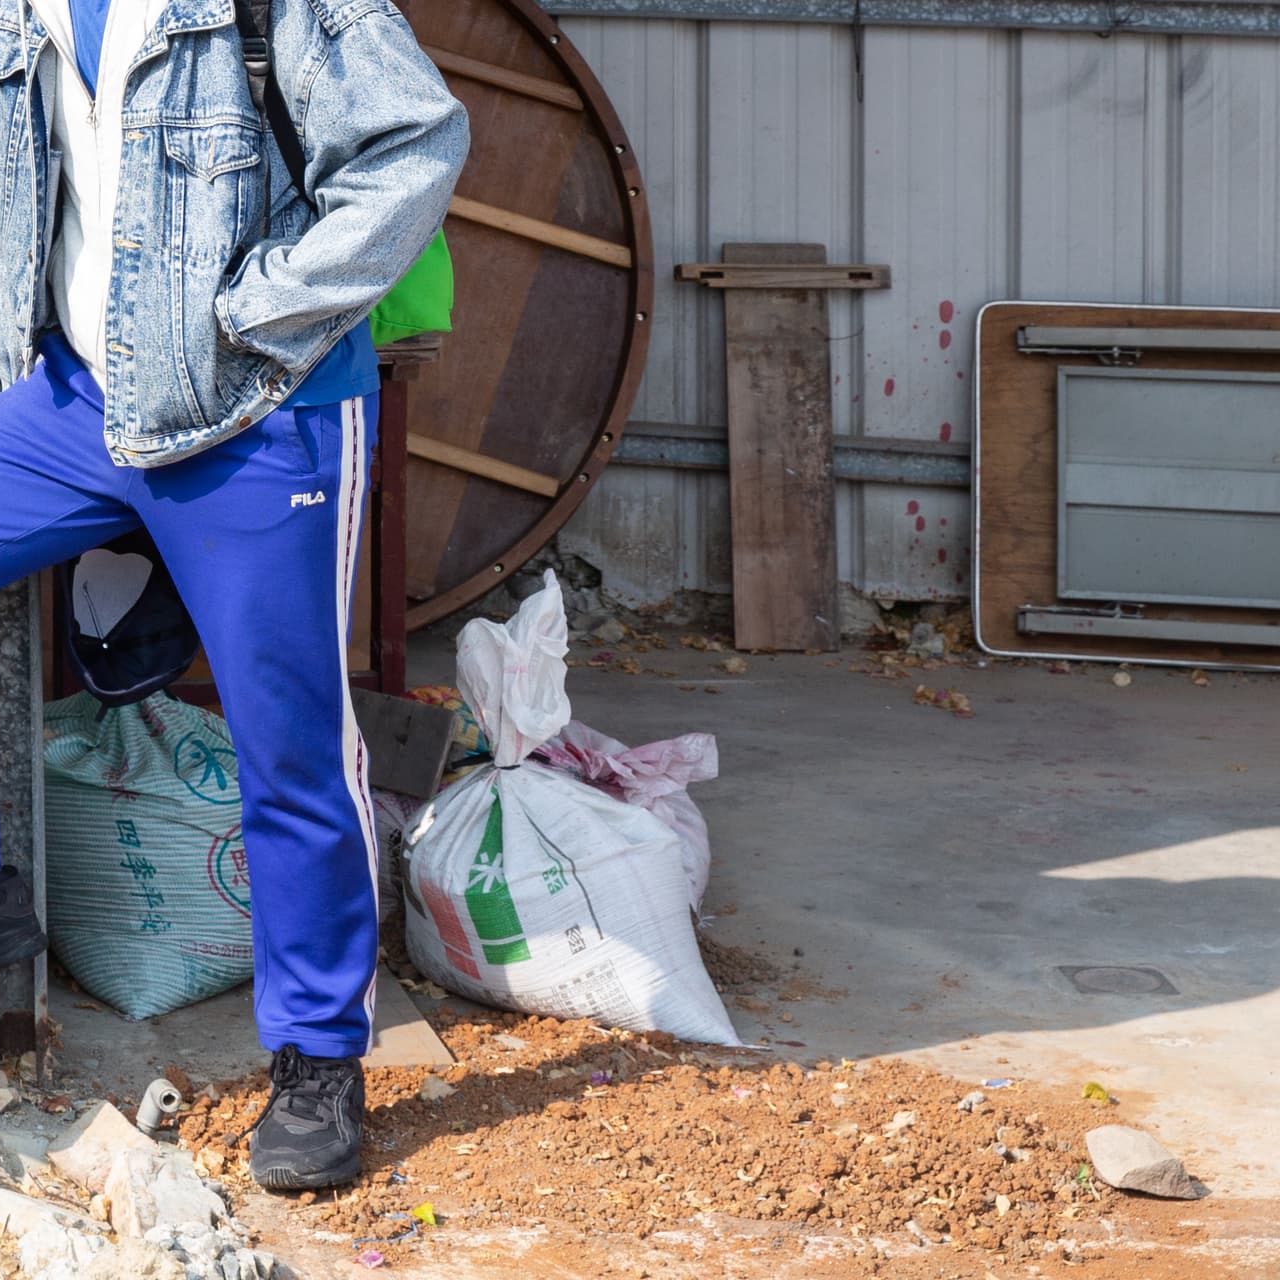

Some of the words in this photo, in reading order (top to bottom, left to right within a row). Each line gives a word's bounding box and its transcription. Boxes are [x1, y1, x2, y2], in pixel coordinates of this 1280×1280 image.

[291, 491, 327, 508] FILA
[114, 819, 172, 934] 四季平安
